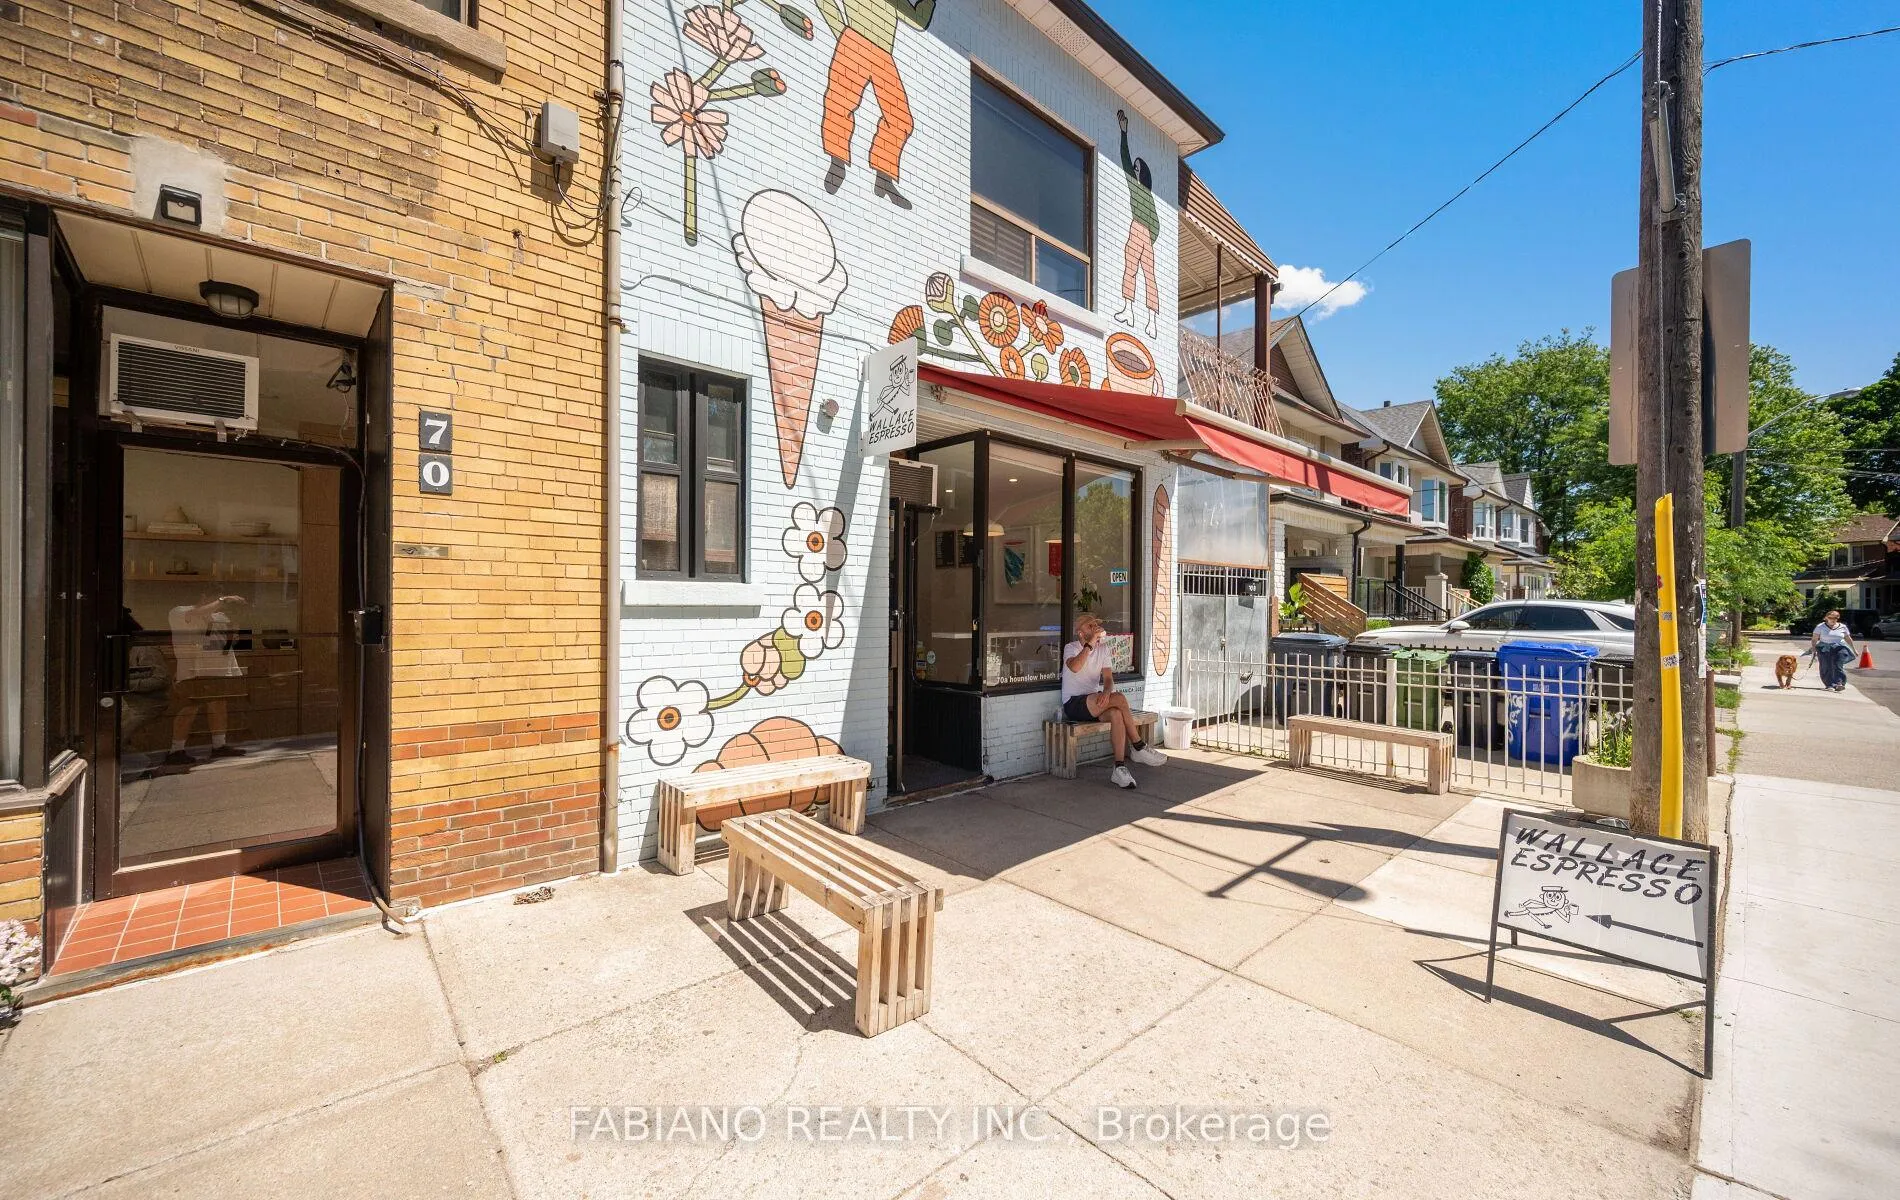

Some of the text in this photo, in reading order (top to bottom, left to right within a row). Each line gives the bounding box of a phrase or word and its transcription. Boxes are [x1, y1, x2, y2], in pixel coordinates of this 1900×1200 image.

[869, 408, 915, 433] WALLACE
[869, 421, 914, 444] ESPRESSO
[1111, 572, 1127, 583] OPEN
[997, 676, 1008, 684] 70a
[1009, 674, 1038, 683] hounslow
[1039, 672, 1056, 680] heath
[1515, 827, 1707, 881] WALLACE
[1510, 847, 1704, 905] ESPRESSO
